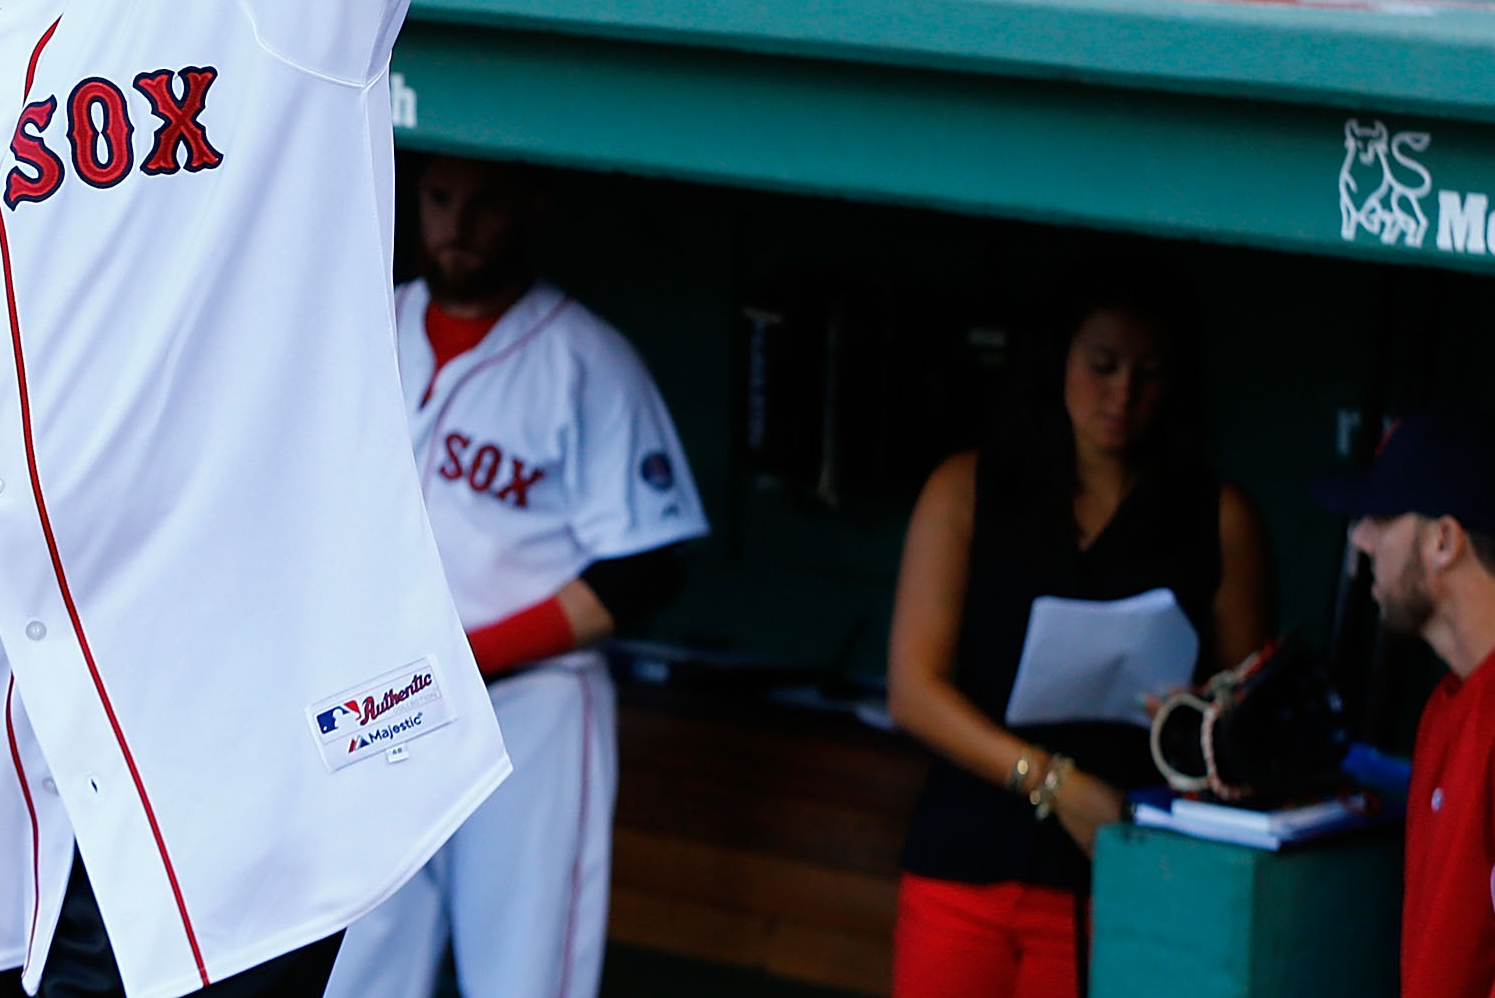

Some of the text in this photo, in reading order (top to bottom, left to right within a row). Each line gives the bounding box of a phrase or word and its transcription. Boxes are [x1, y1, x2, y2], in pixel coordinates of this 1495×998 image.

[3, 66, 224, 212] SOX
[439, 432, 544, 508] SOX
[359, 673, 433, 726] Authentic
[368, 716, 422, 744] Majestic
